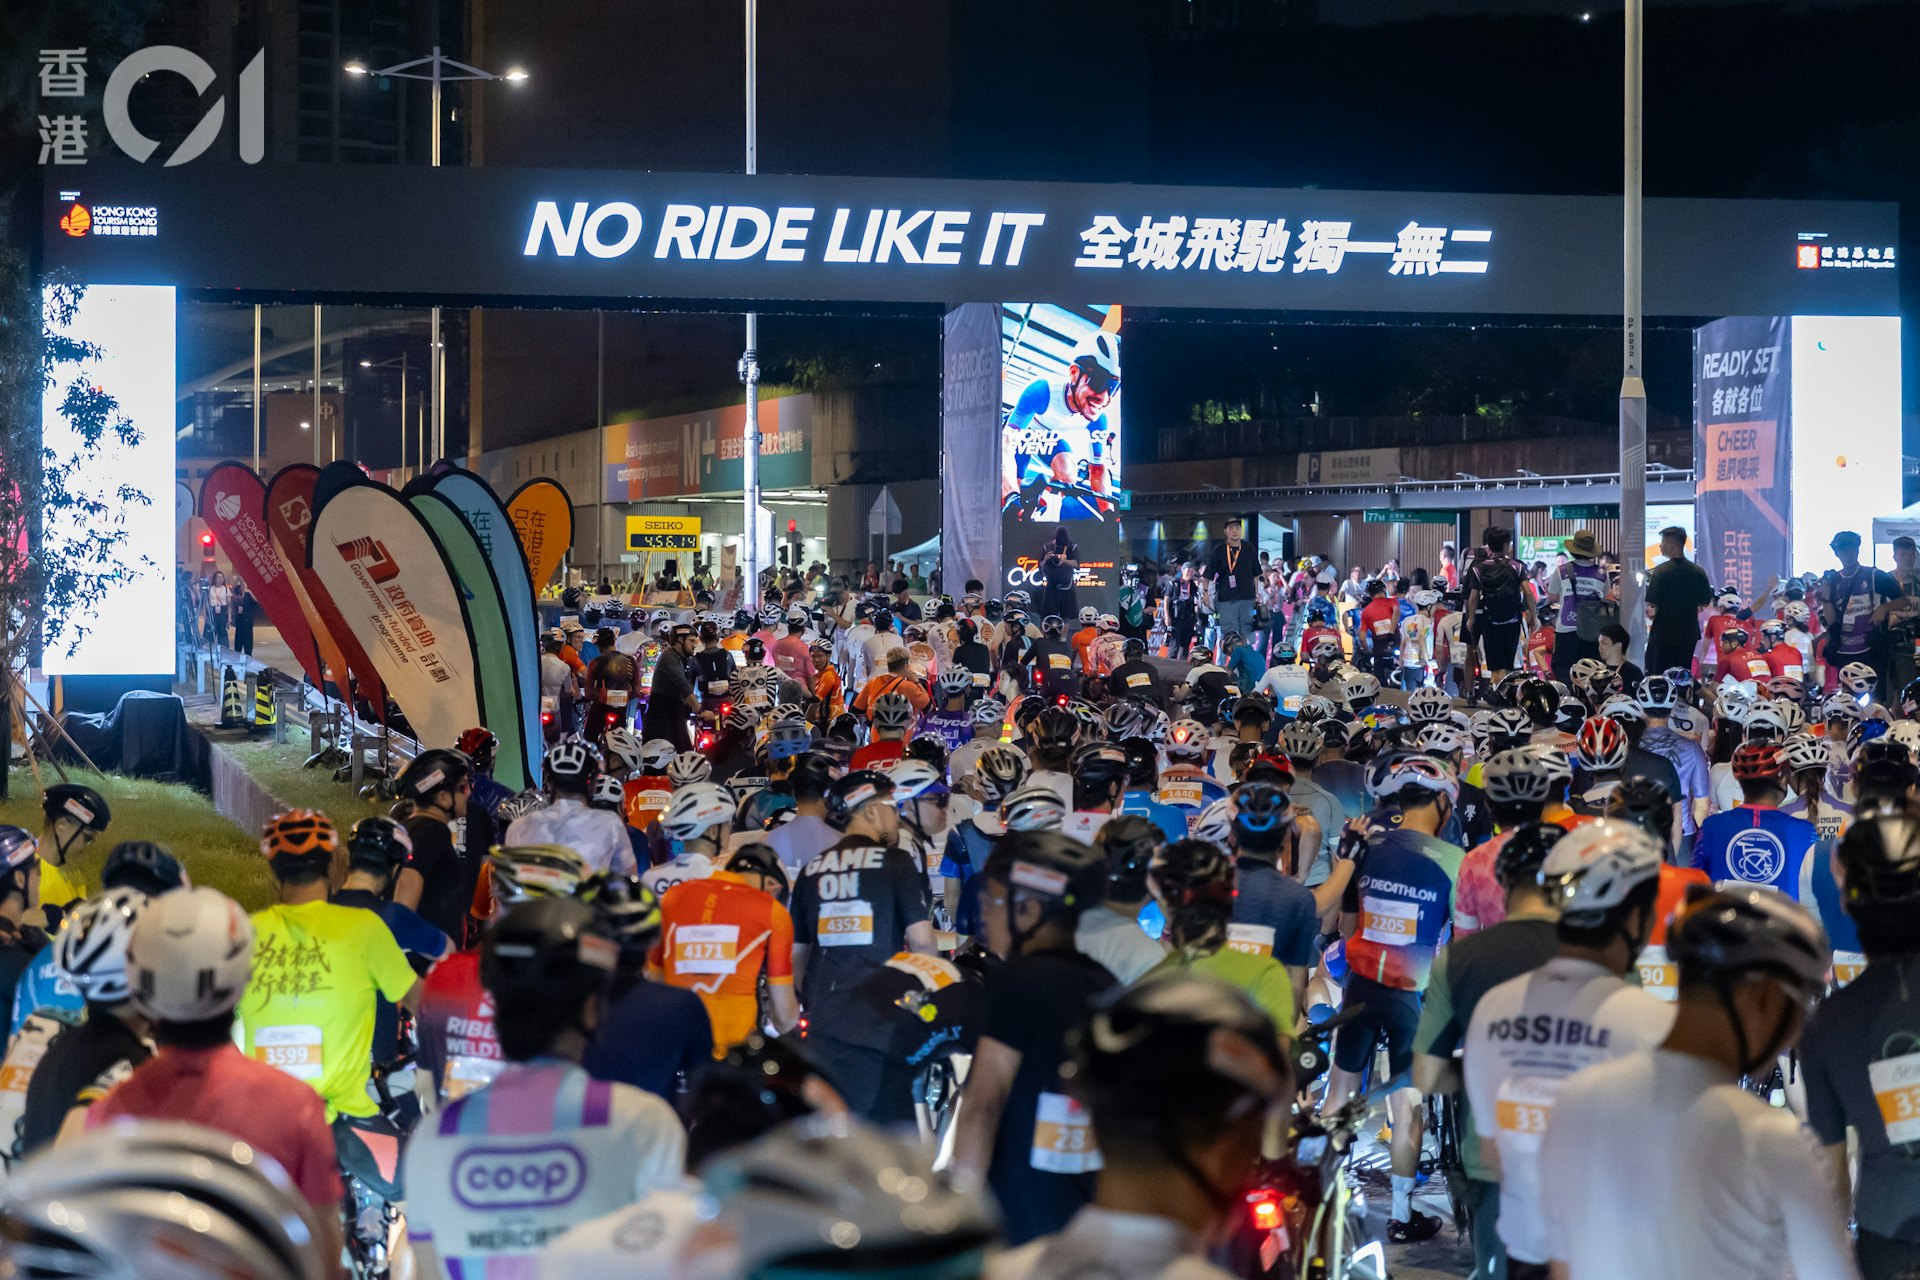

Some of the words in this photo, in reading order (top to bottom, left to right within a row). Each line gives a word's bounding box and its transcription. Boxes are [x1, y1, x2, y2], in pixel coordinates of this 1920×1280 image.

[92, 206, 125, 217] HONG
[126, 206, 158, 217] KONG
[92, 217, 129, 225] TOURISM
[129, 218, 158, 226] BOARD
[524, 201, 642, 258] NO
[654, 204, 815, 262] RIDE
[823, 208, 970, 265] LIKE
[979, 212, 1045, 266] IT
[1702, 350, 1751, 379] READY,
[1712, 384, 1764, 416] 各就各位
[1717, 429, 1757, 452] CHEER
[644, 521, 684, 530] SEIKO
[1367, 512, 1385, 521] 77M
[237, 518, 260, 553] TOURISM
[257, 551, 278, 578] BOARD
[242, 512, 266, 544] HONG
[263, 542, 284, 572] KONG
[1522, 539, 1535, 559] 26
[350, 563, 417, 653] Government-funded
[371, 615, 409, 664] programme
[384, 584, 436, 648] 政府資助
[420, 652, 450, 683] 計劃
[926, 714, 973, 728] Jayco
[645, 796, 667, 804] 3308
[1168, 790, 1195, 799] 1440
[805, 847, 886, 877] GAME
[818, 871, 860, 900] ON
[1370, 878, 1437, 902] DECATHLON
[826, 918, 861, 931] 4352
[1371, 915, 1406, 933] 2205
[683, 944, 724, 960] 4171
[1488, 1015, 1611, 1048] POSSIBLE
[265, 1046, 308, 1065] 3599
[467, 1162, 568, 1195] coop
